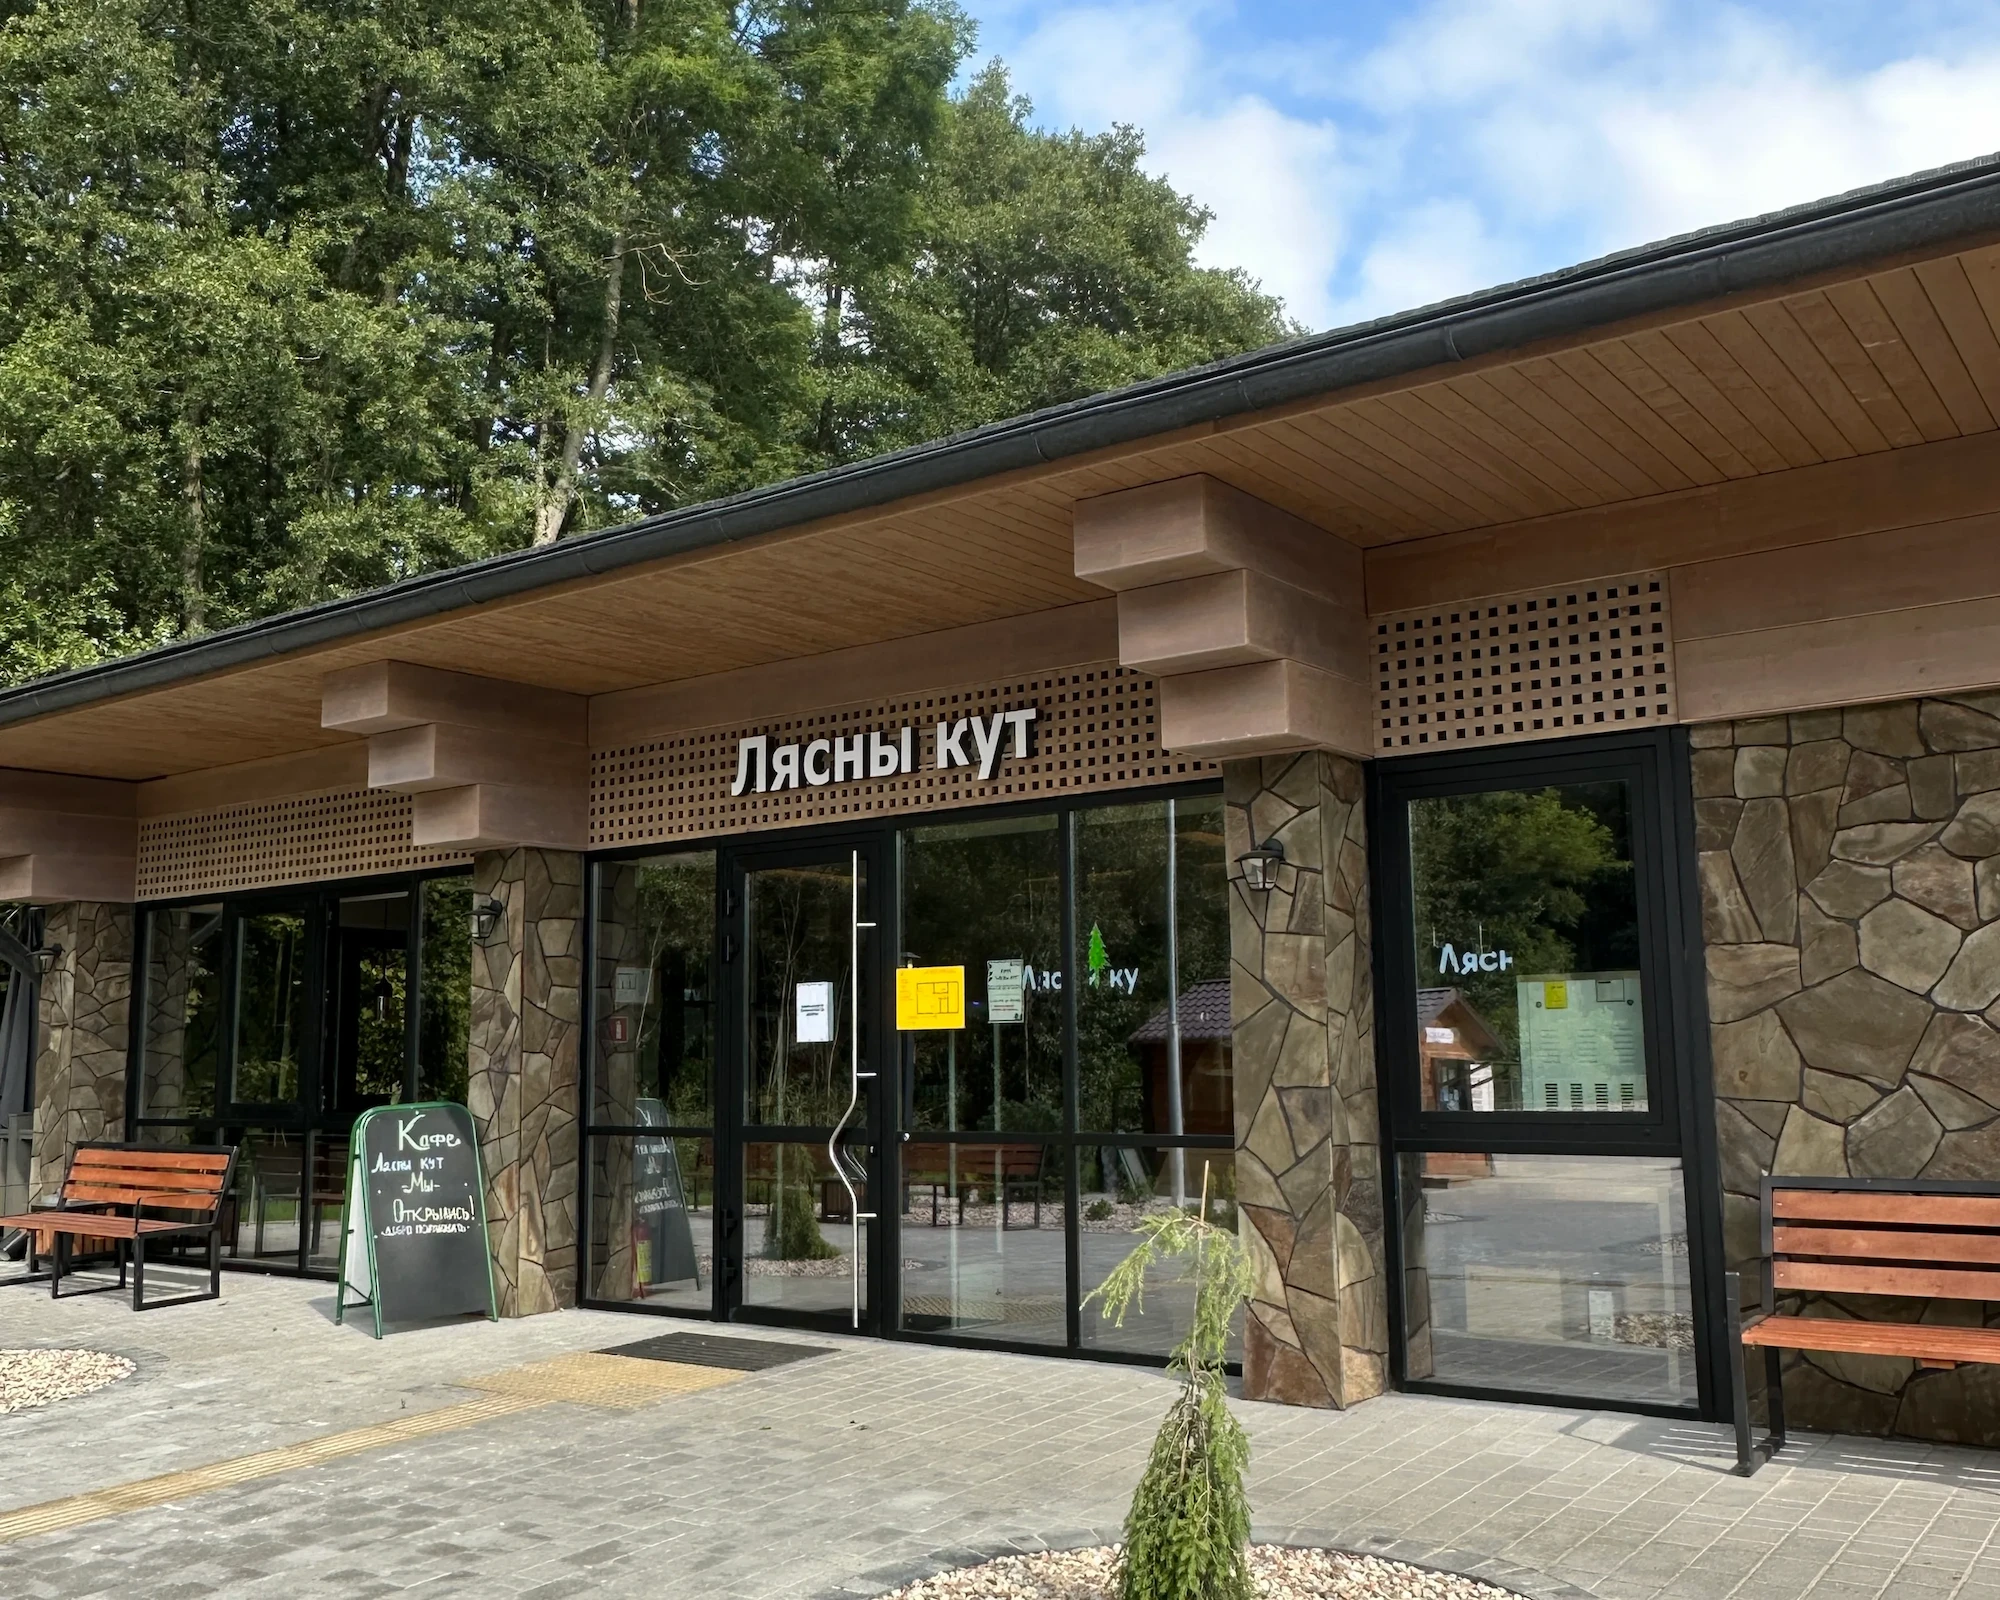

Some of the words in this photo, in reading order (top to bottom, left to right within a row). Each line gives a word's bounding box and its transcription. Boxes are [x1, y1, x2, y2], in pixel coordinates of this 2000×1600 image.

[730, 727, 914, 797] Лясны
[936, 707, 1039, 780] кут
[398, 1113, 461, 1152] Кафе
